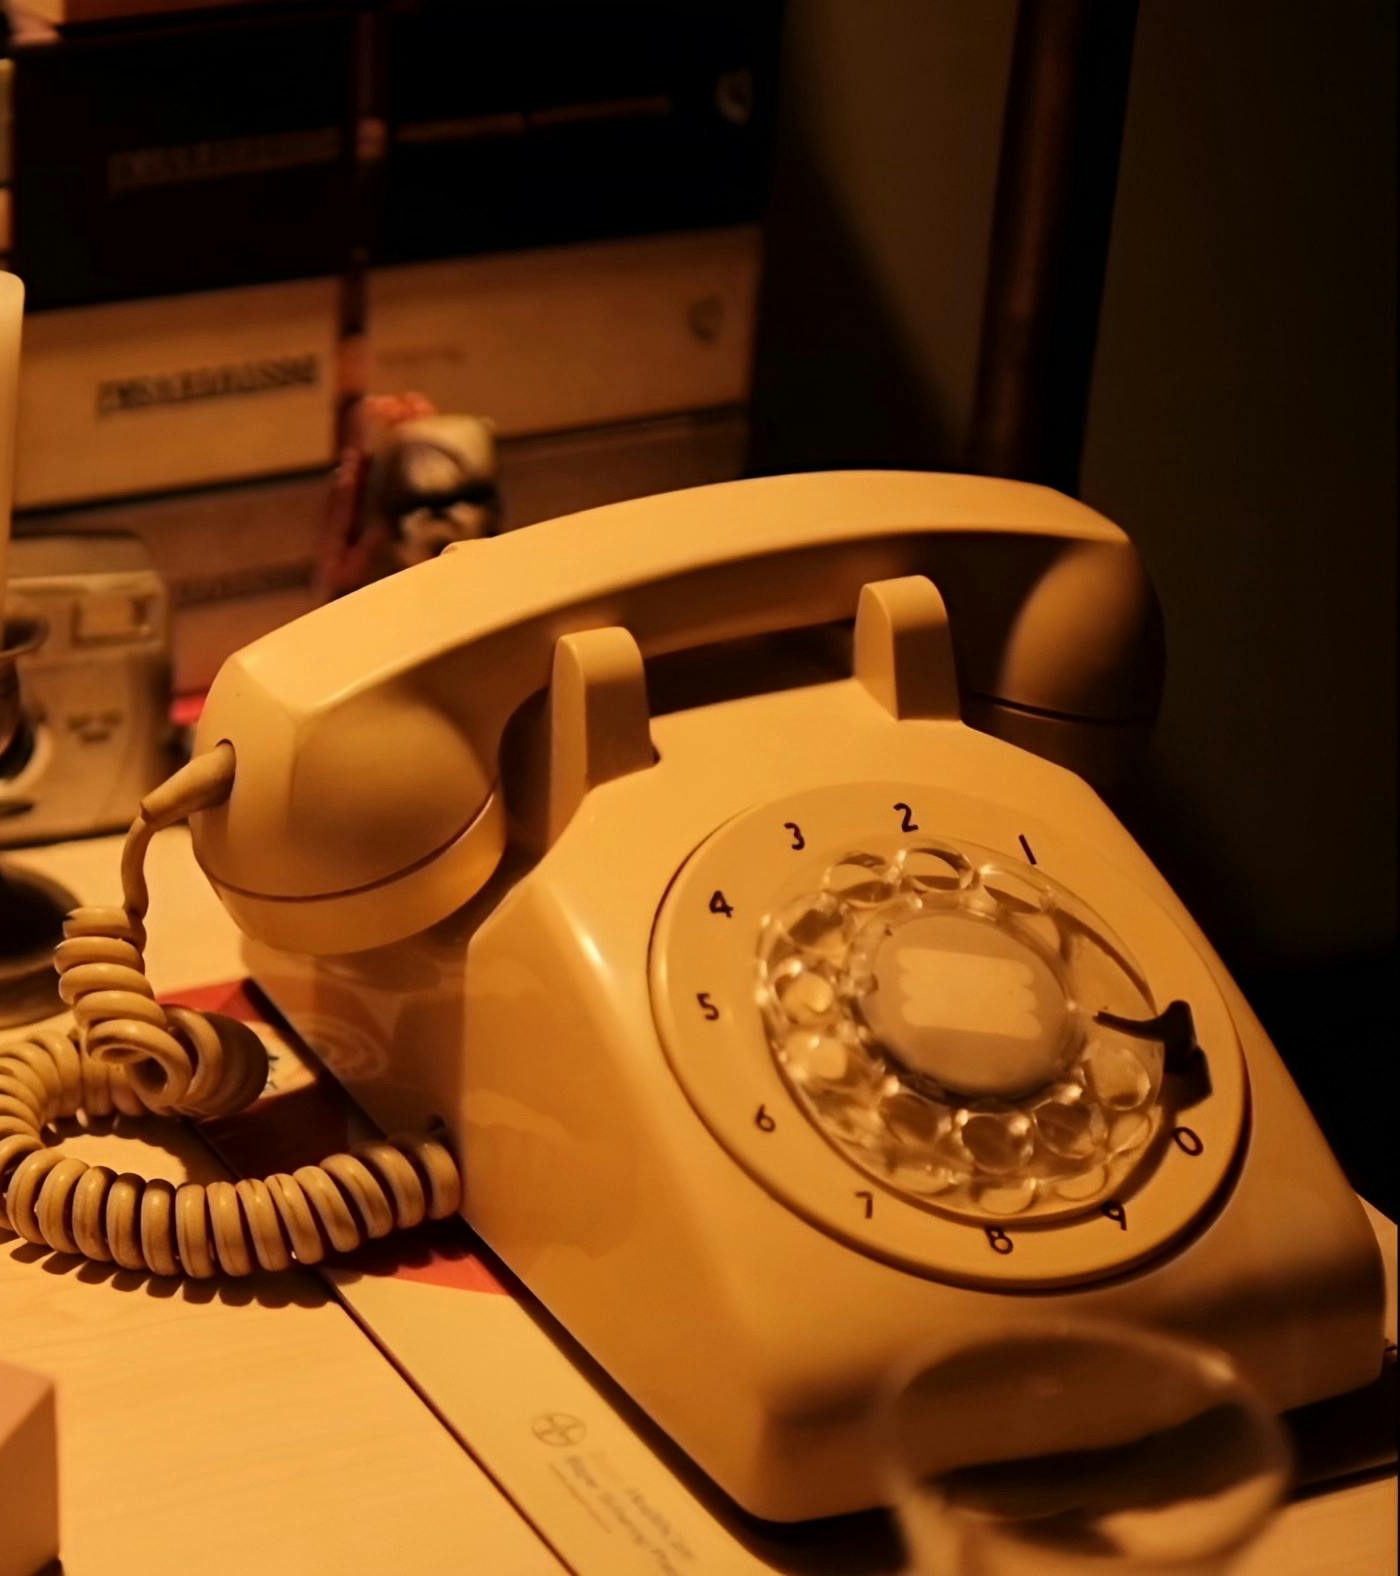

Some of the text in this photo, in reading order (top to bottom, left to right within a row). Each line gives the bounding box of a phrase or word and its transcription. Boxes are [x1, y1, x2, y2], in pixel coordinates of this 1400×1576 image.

[893, 803, 919, 832] 2
[783, 822, 805, 850] 3
[1018, 834, 1037, 865] 1
[709, 890, 734, 918] 4
[696, 993, 720, 1020] 5
[755, 1104, 776, 1132] 6
[1172, 1127, 1204, 1156] 0
[856, 1191, 873, 1220] 7
[1102, 1200, 1128, 1231] 9
[985, 1224, 1014, 1255] 8
